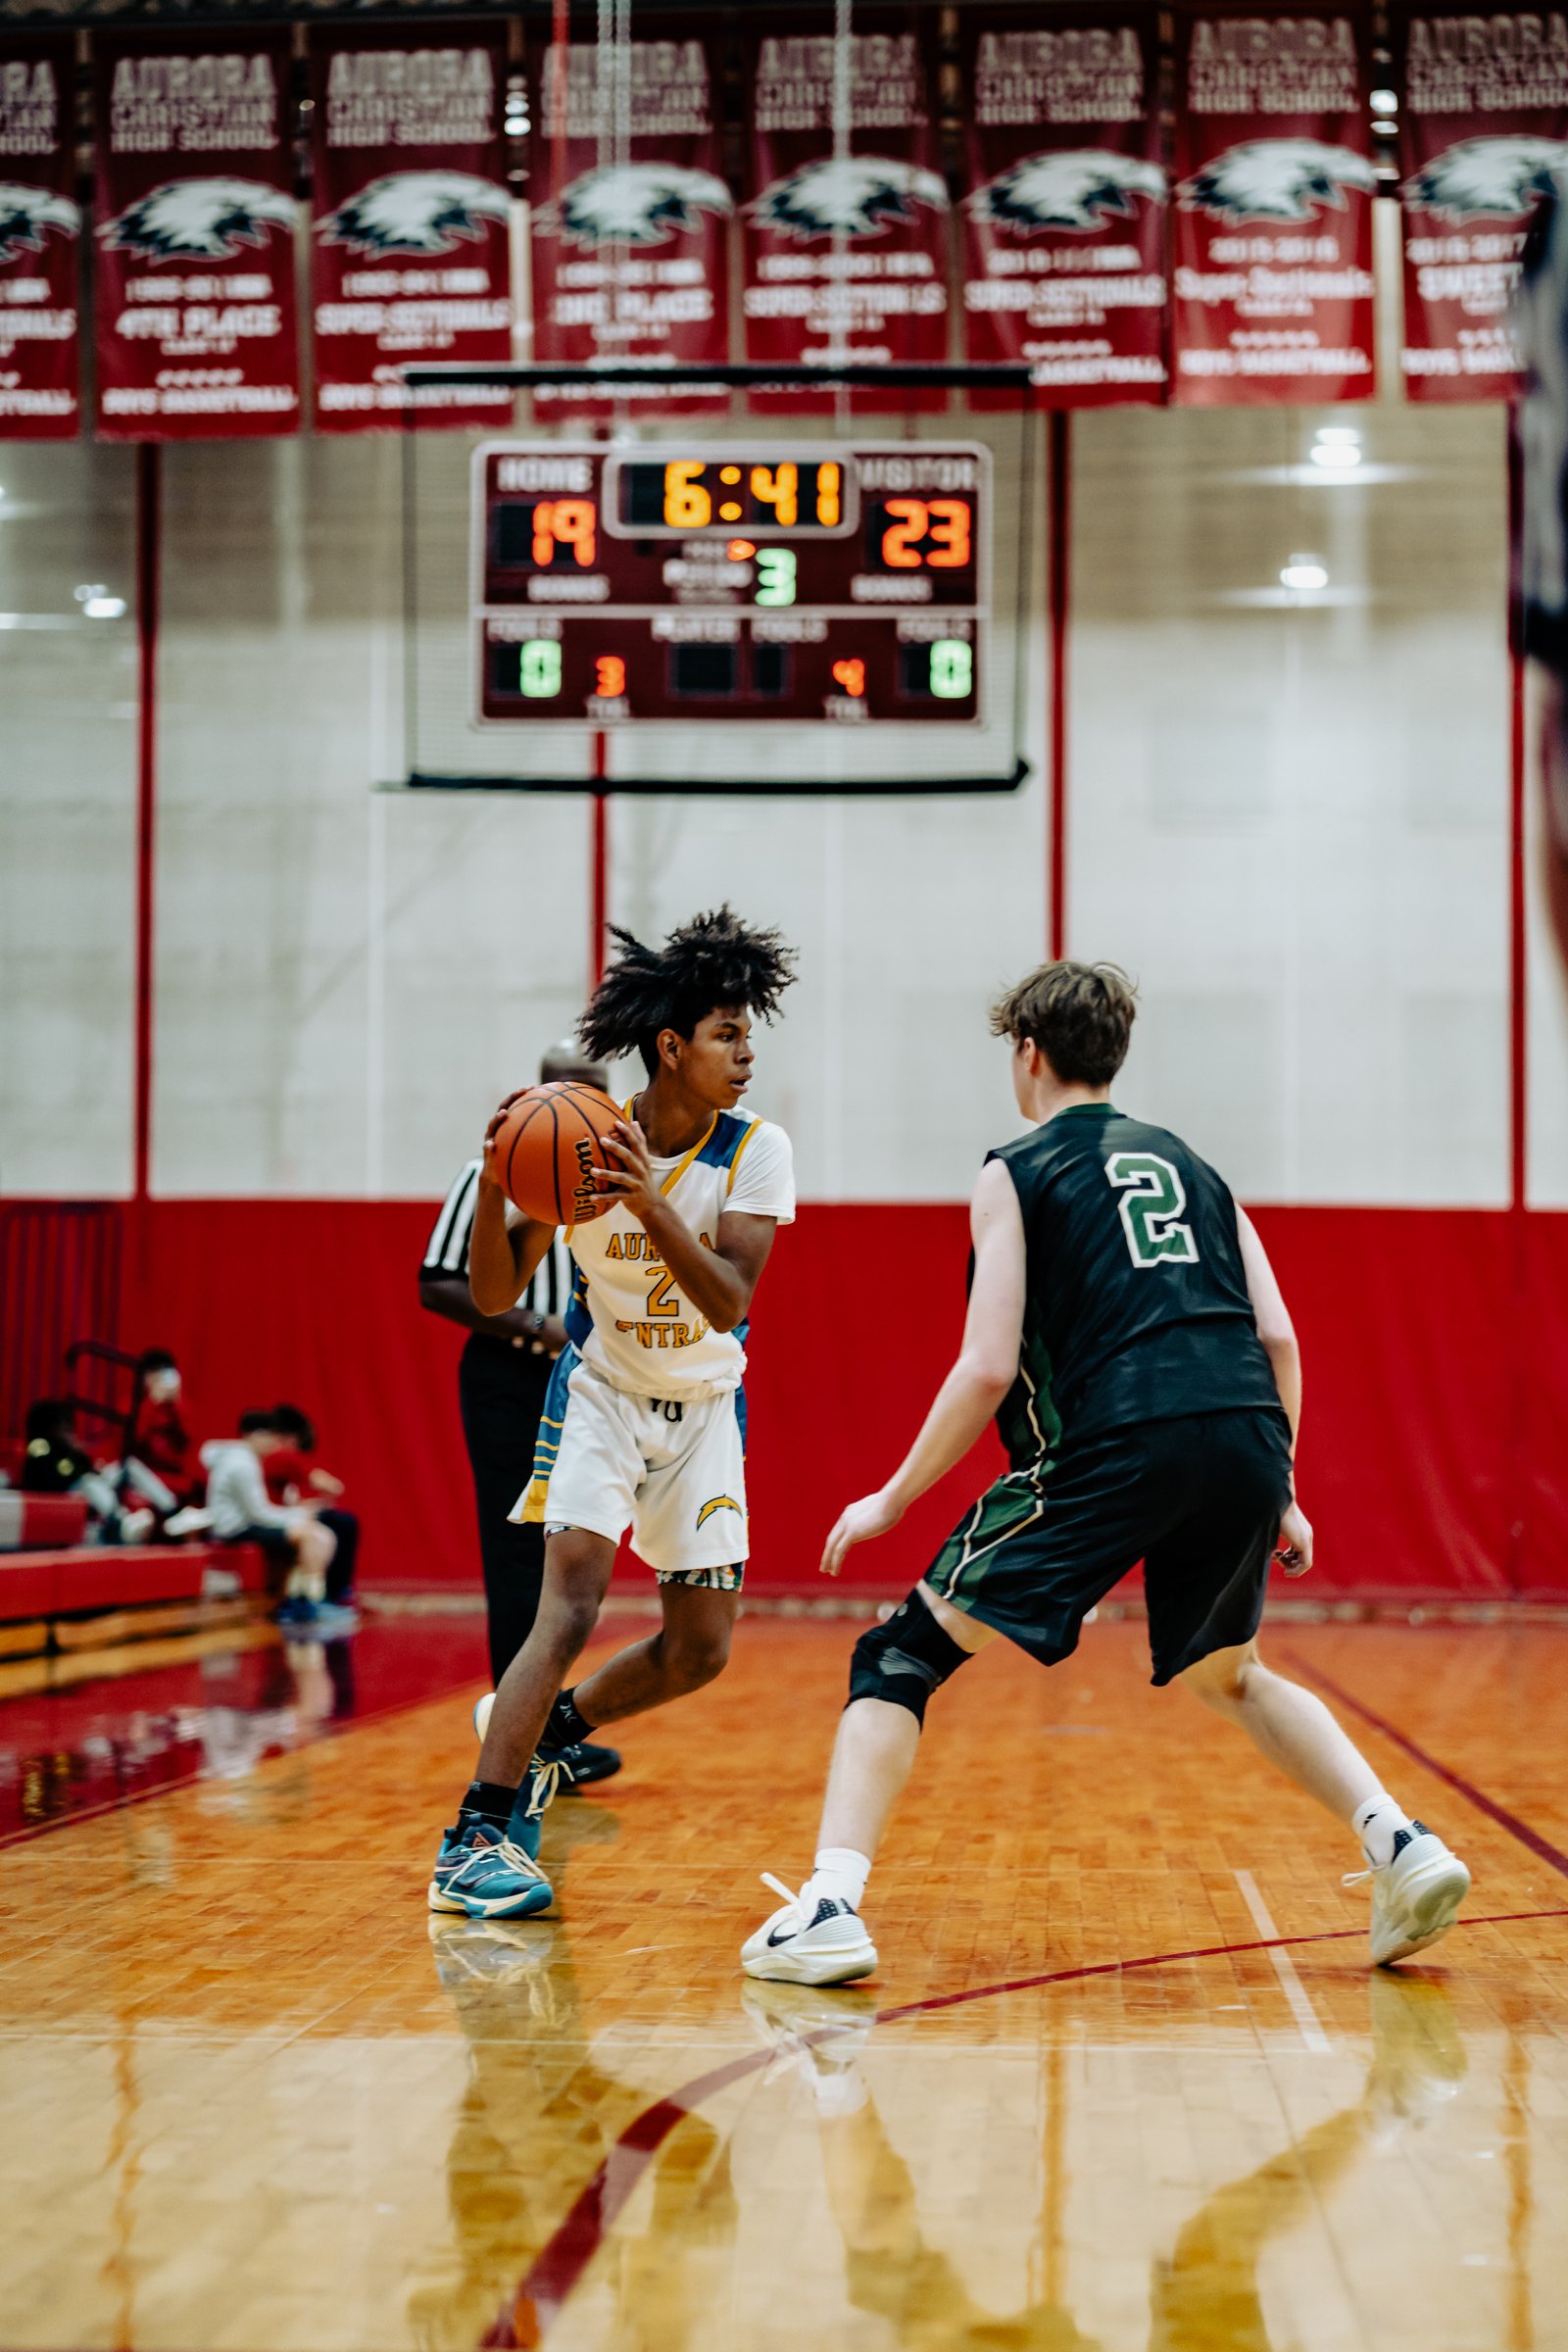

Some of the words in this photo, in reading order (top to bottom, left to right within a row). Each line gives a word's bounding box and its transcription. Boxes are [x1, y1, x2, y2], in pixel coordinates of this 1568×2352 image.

[663, 461, 840, 527] 6:41
[533, 500, 595, 566] 19
[882, 499, 970, 567] 23
[755, 548, 797, 606] 3
[520, 639, 562, 698] 0
[596, 656, 625, 697] 3
[930, 639, 972, 698] 0
[1104, 1152, 1200, 1268] 2
[645, 1264, 679, 1316] 2
